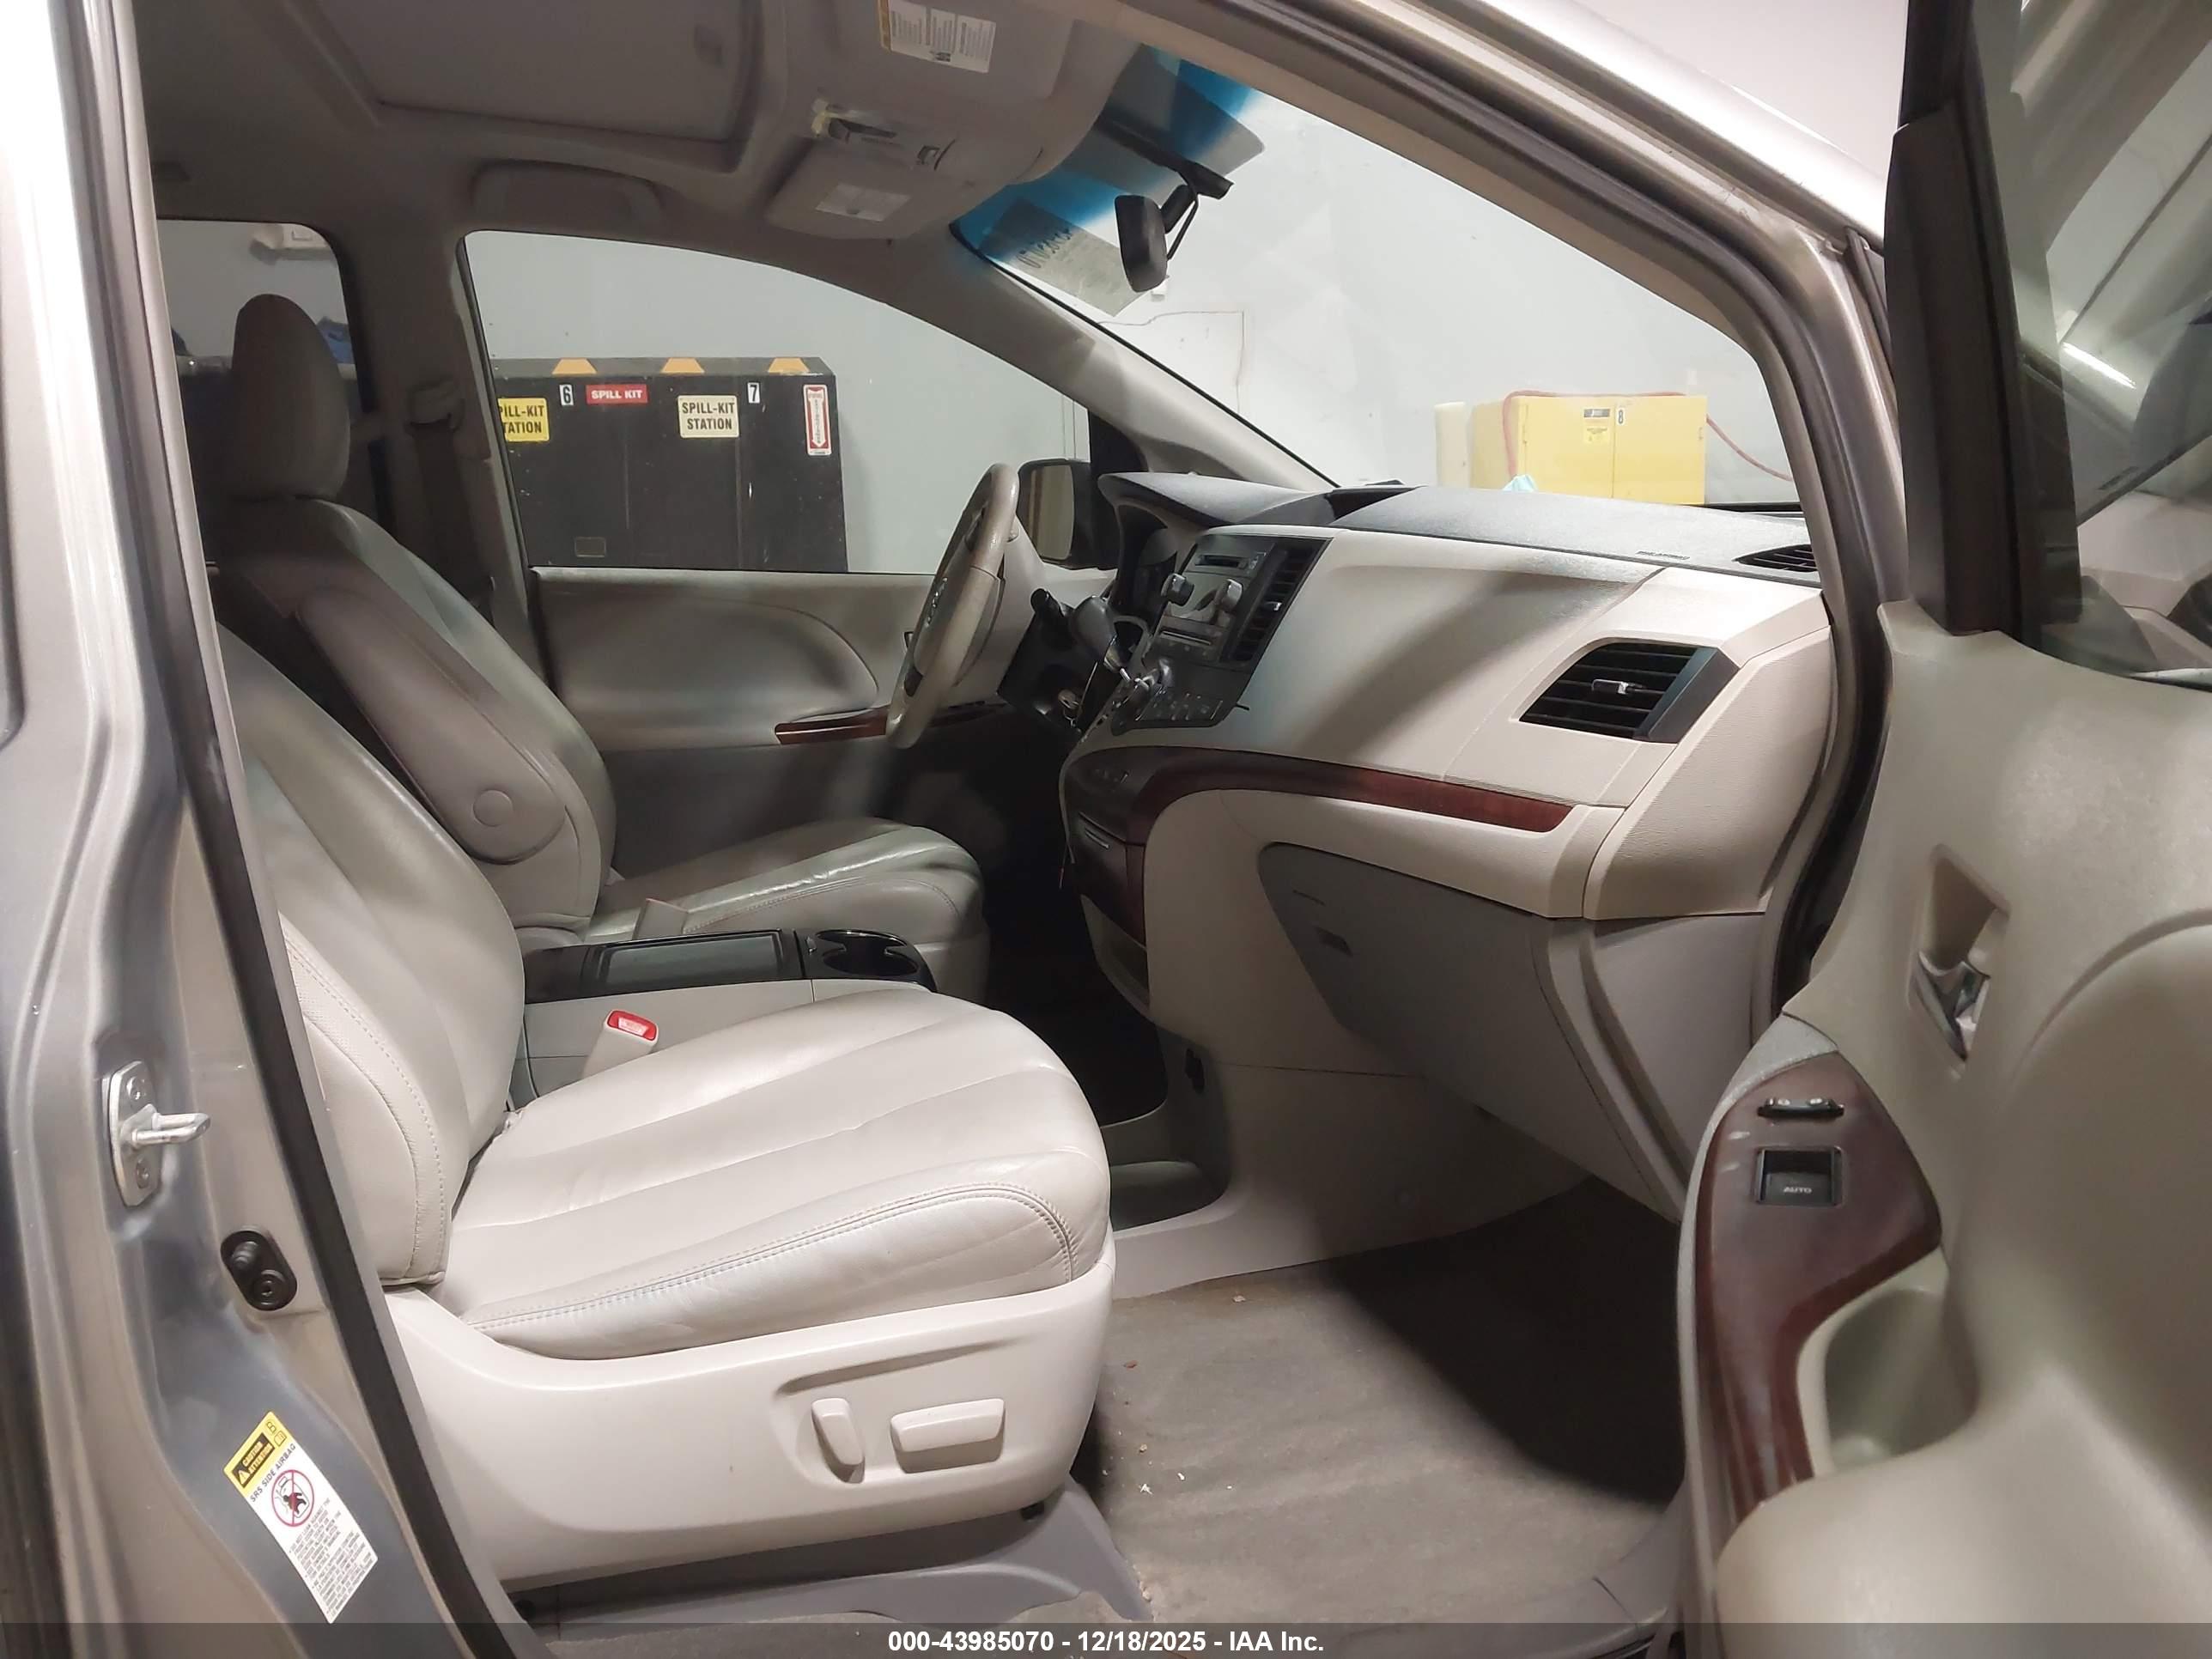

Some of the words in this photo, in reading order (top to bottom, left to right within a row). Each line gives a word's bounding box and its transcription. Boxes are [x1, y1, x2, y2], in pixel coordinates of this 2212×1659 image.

[563, 386, 571, 404] 6
[591, 390, 622, 399] SPILL
[624, 389, 642, 398] KIT
[750, 385, 757, 402] 7
[499, 404, 544, 417] PILL-KIT
[682, 402, 735, 414] SPILL-KIT
[503, 421, 542, 434] TATION
[687, 418, 732, 430] STATION
[250, 1486, 264, 1502] SRS
[261, 1469, 276, 1488] SIDE
[275, 1443, 296, 1470] AIRBAG
